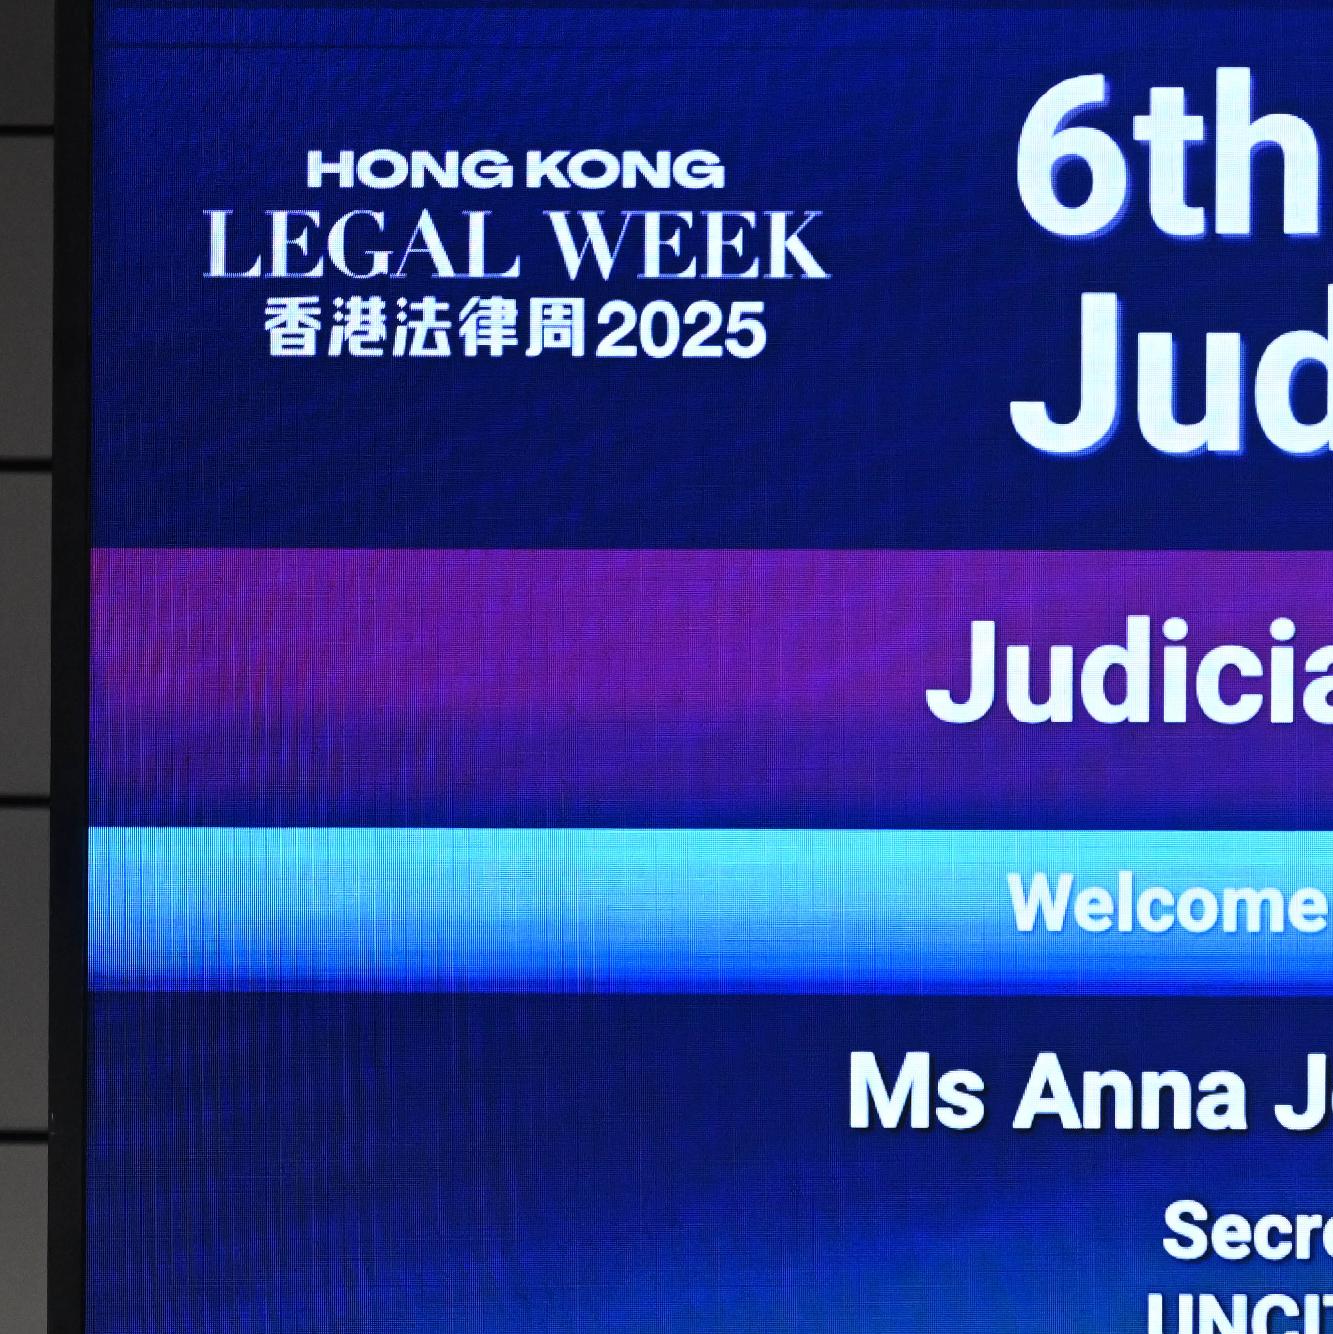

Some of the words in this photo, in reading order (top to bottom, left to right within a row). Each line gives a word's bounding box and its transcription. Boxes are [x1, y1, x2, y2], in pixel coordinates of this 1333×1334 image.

[308, 150, 513, 188] HONG
[527, 149, 724, 188] KONG
[1018, 68, 1318, 235] 6th
[204, 209, 520, 278] LEGAL
[549, 211, 828, 280] WEEK
[265, 296, 766, 358] 香港法律周2025
[1008, 871, 1326, 931] Welcome
[851, 1052, 984, 1128] Ms
[1013, 1053, 1246, 1129] Anna
